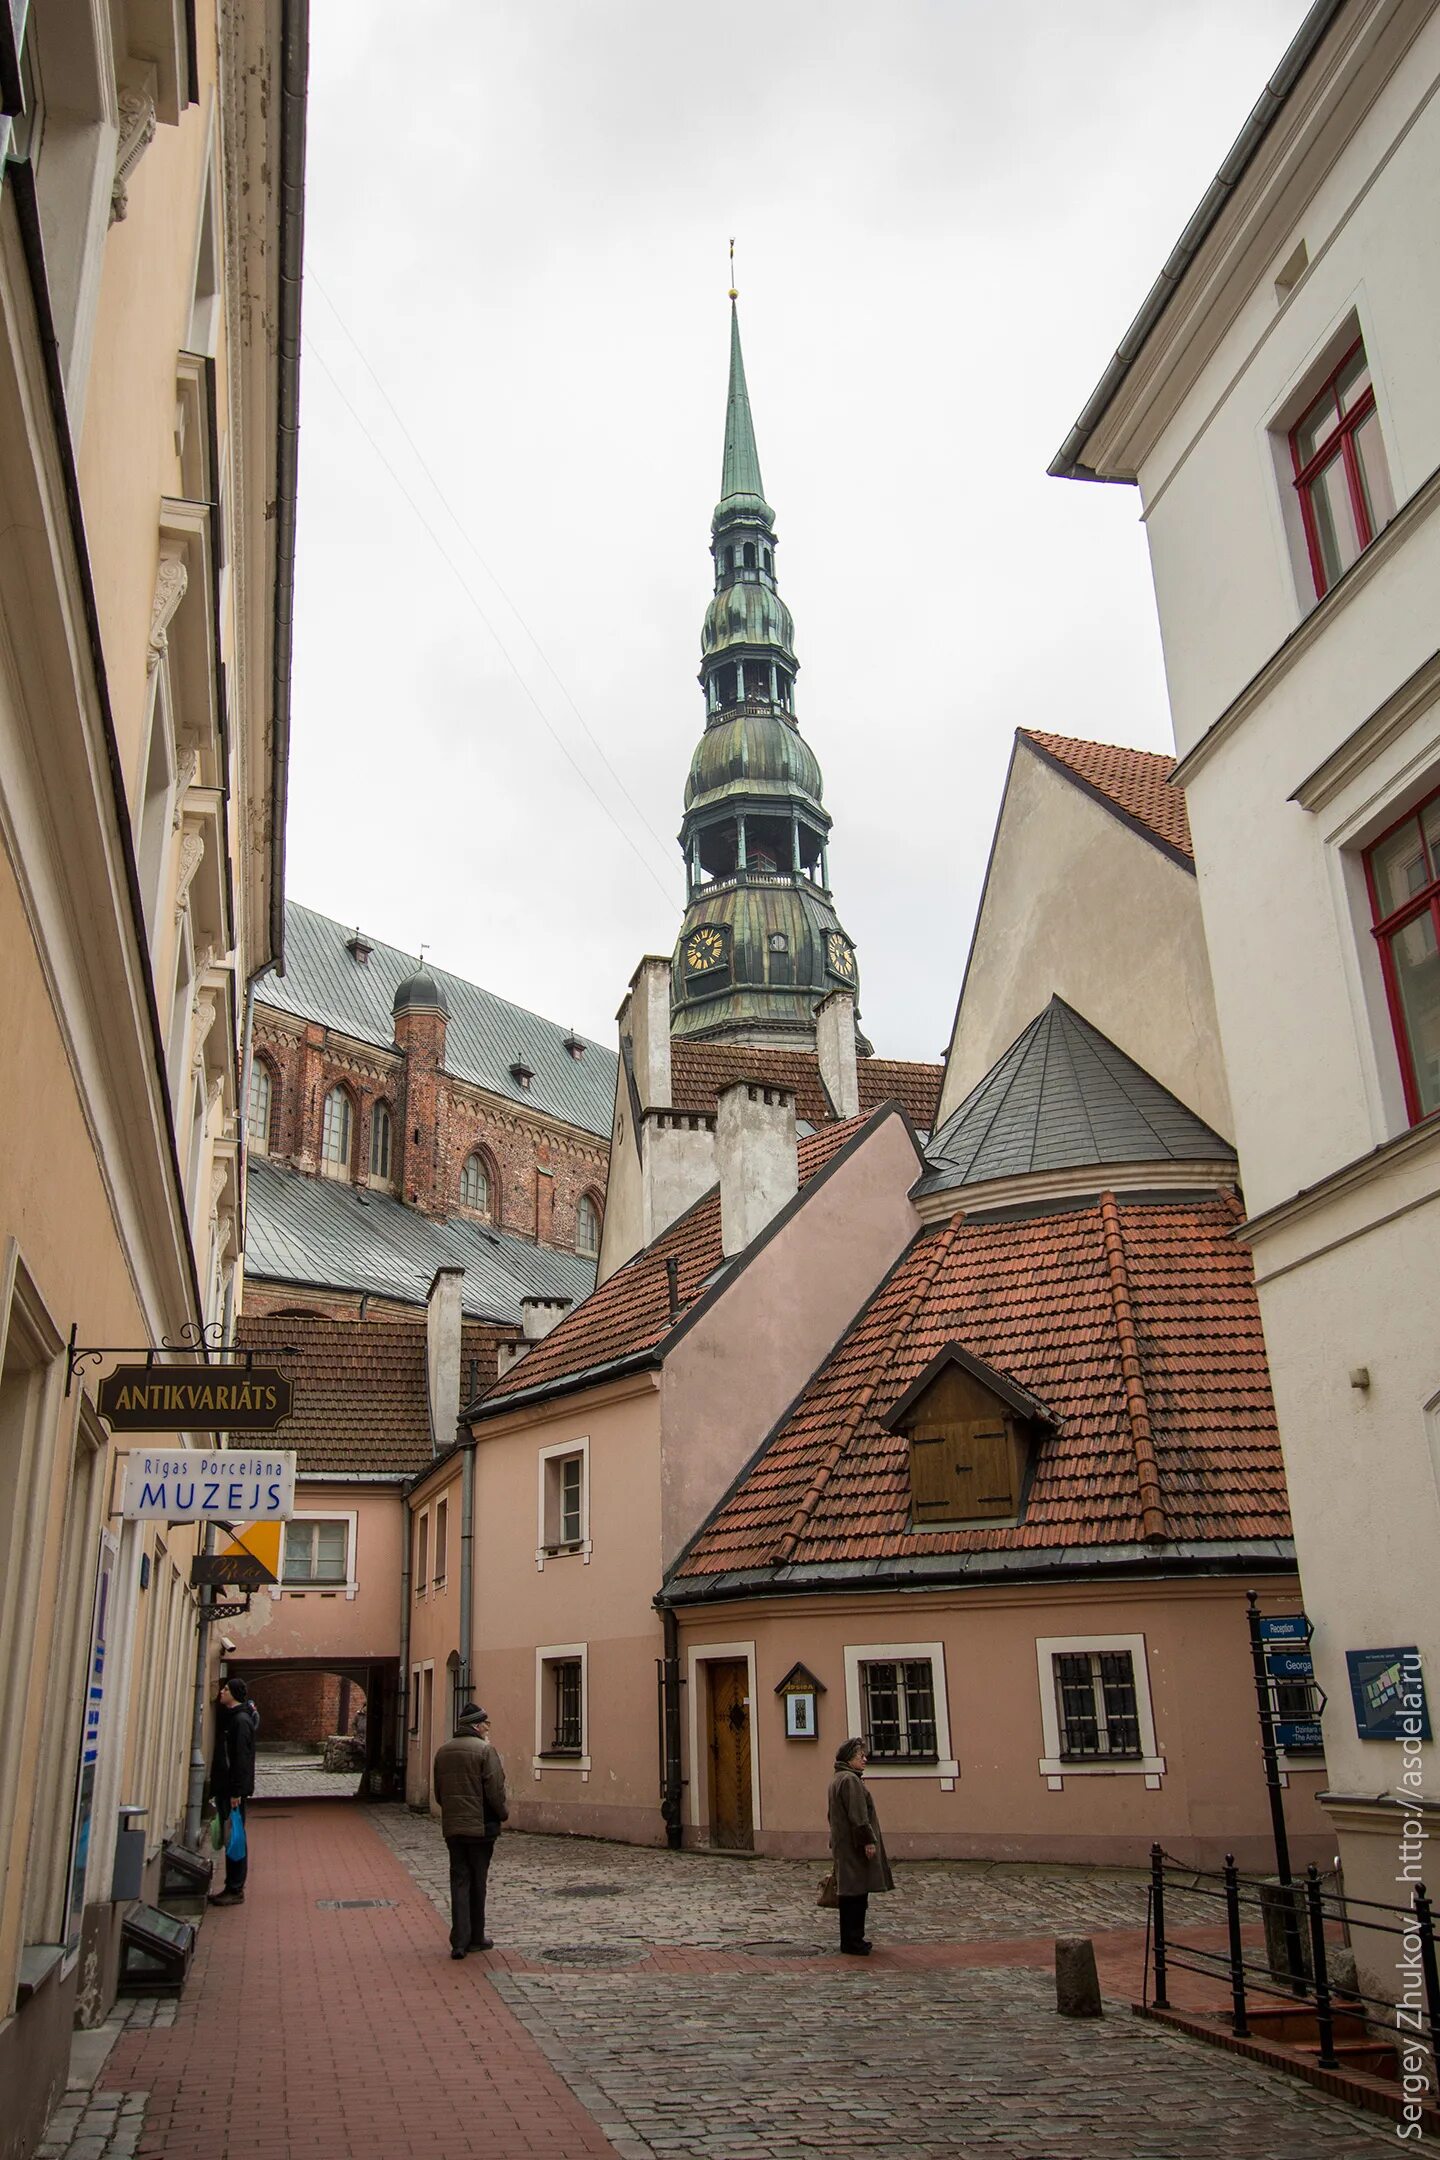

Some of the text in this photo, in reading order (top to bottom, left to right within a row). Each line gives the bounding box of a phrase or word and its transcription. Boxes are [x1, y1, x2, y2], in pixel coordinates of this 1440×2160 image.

[115, 1382, 277, 1411] ANTIKVARIĀTS
[144, 1458, 283, 1479] Rīgas Porcelāna
[139, 1483, 281, 1511] MUZEJS
[1269, 1623, 1295, 1635] Reception
